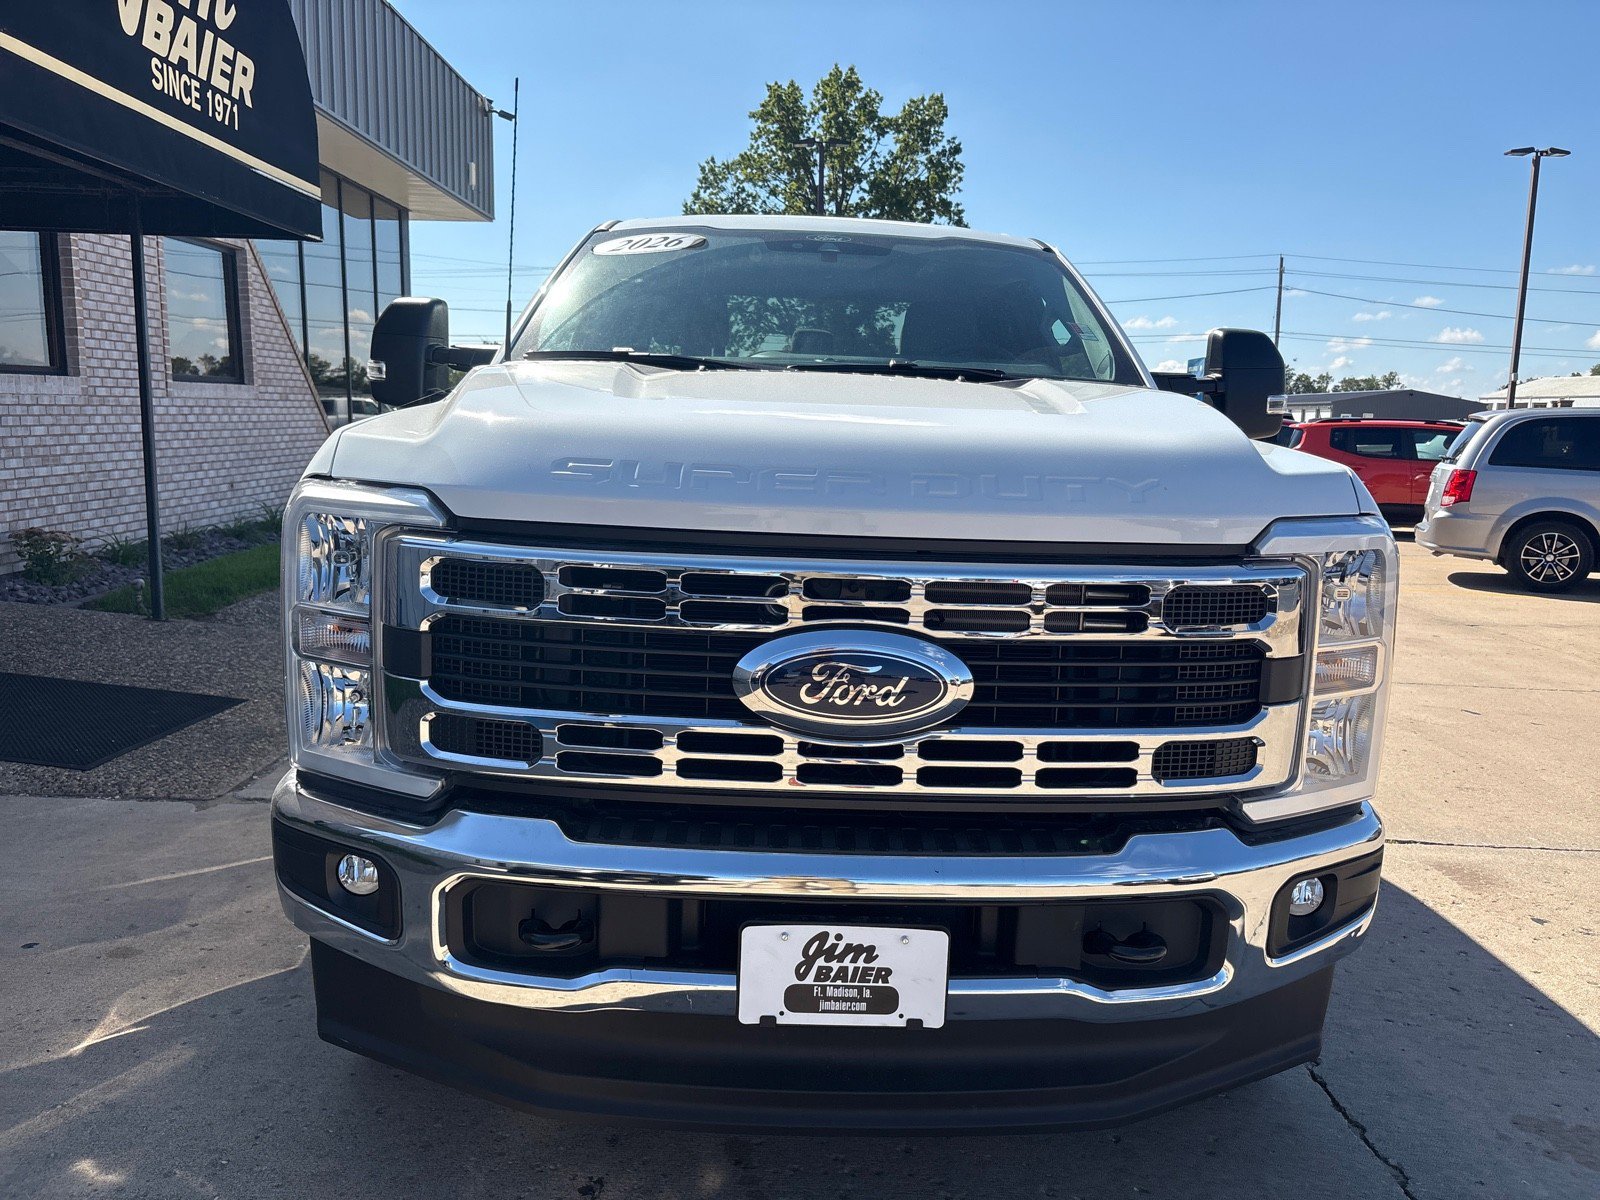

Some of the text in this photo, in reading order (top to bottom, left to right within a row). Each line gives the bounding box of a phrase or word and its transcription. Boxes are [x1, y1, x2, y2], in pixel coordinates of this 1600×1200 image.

[141, 0, 255, 108] BAIER
[151, 57, 239, 131] SINCE 1971
[607, 236, 688, 252] 2026
[550, 457, 1160, 503] SUPER DUTY
[799, 661, 909, 707] Ford
[795, 931, 879, 981] Jim
[813, 966, 893, 984] BAIER
[813, 985, 824, 997] Ft.
[826, 986, 860, 999] Madison,
[819, 1000, 867, 1012] jimbaier.com
